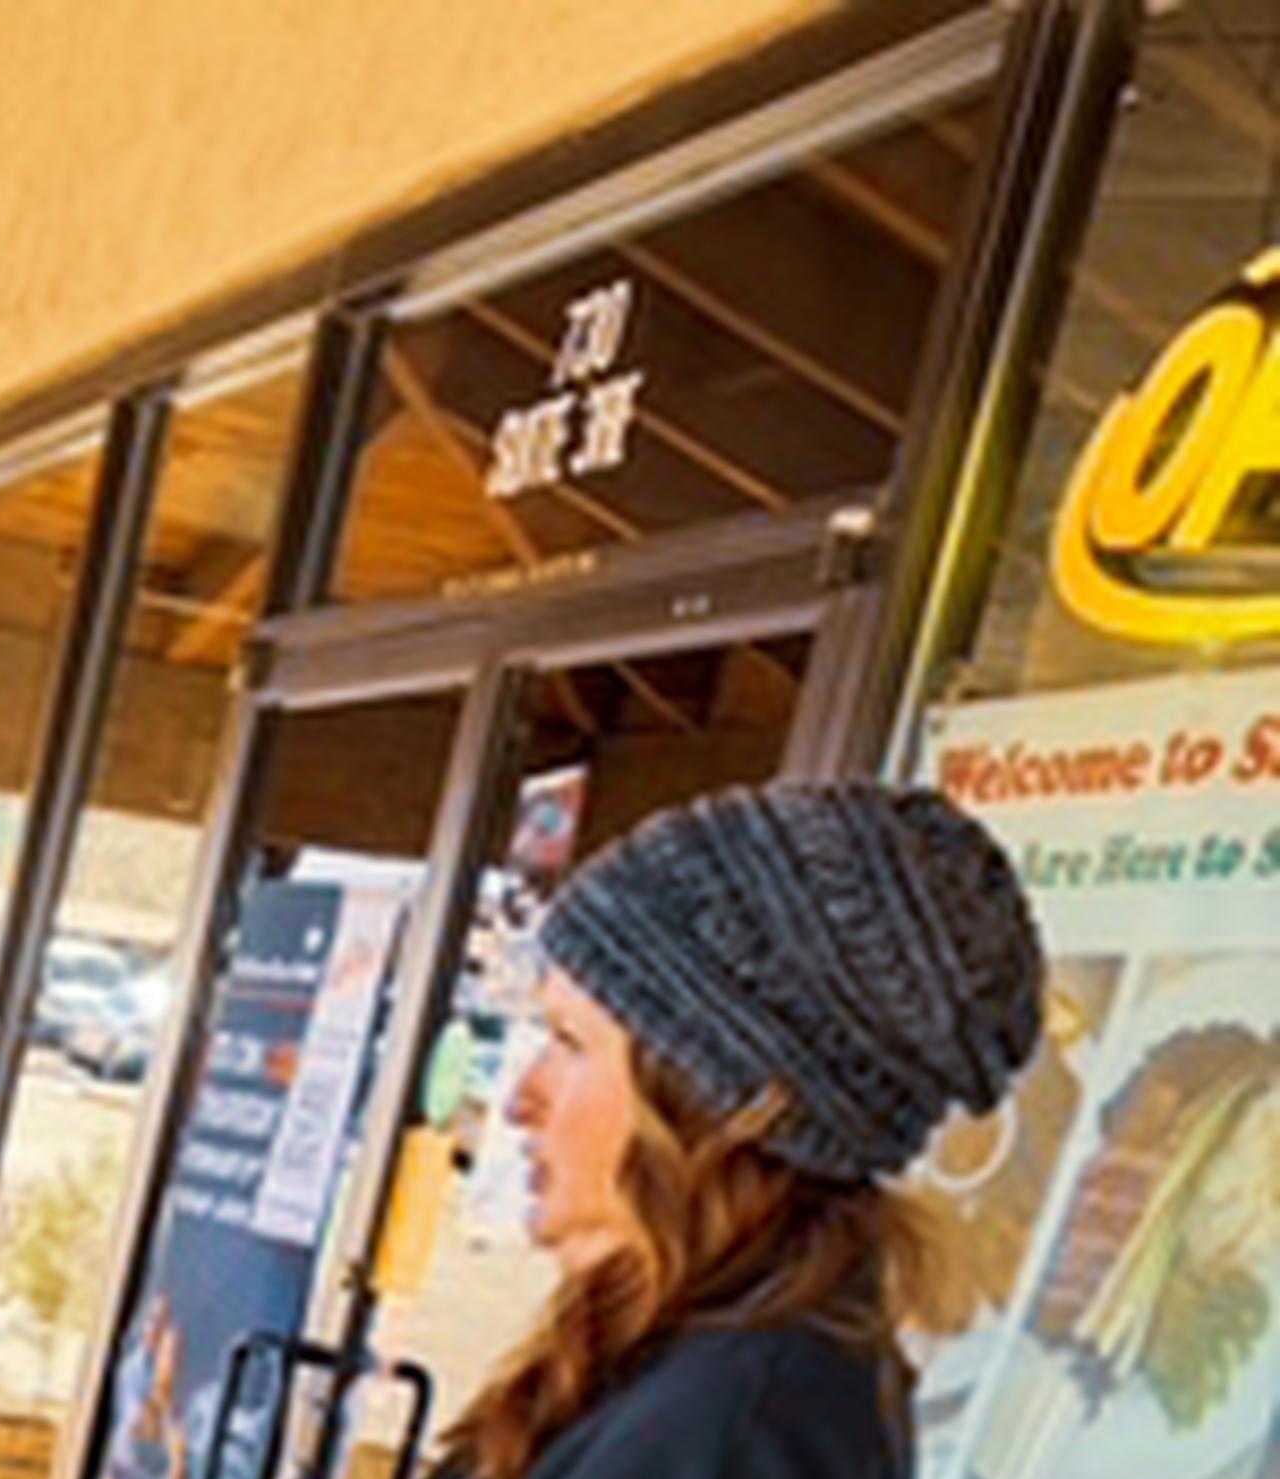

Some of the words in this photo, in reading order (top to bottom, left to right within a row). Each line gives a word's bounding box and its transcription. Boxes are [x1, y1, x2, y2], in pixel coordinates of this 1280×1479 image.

[940, 739, 1151, 803] Welcome
[1160, 730, 1225, 788] to
[1231, 712, 1280, 785] S
[1094, 832, 1186, 885] Here
[1194, 832, 1245, 881] to
